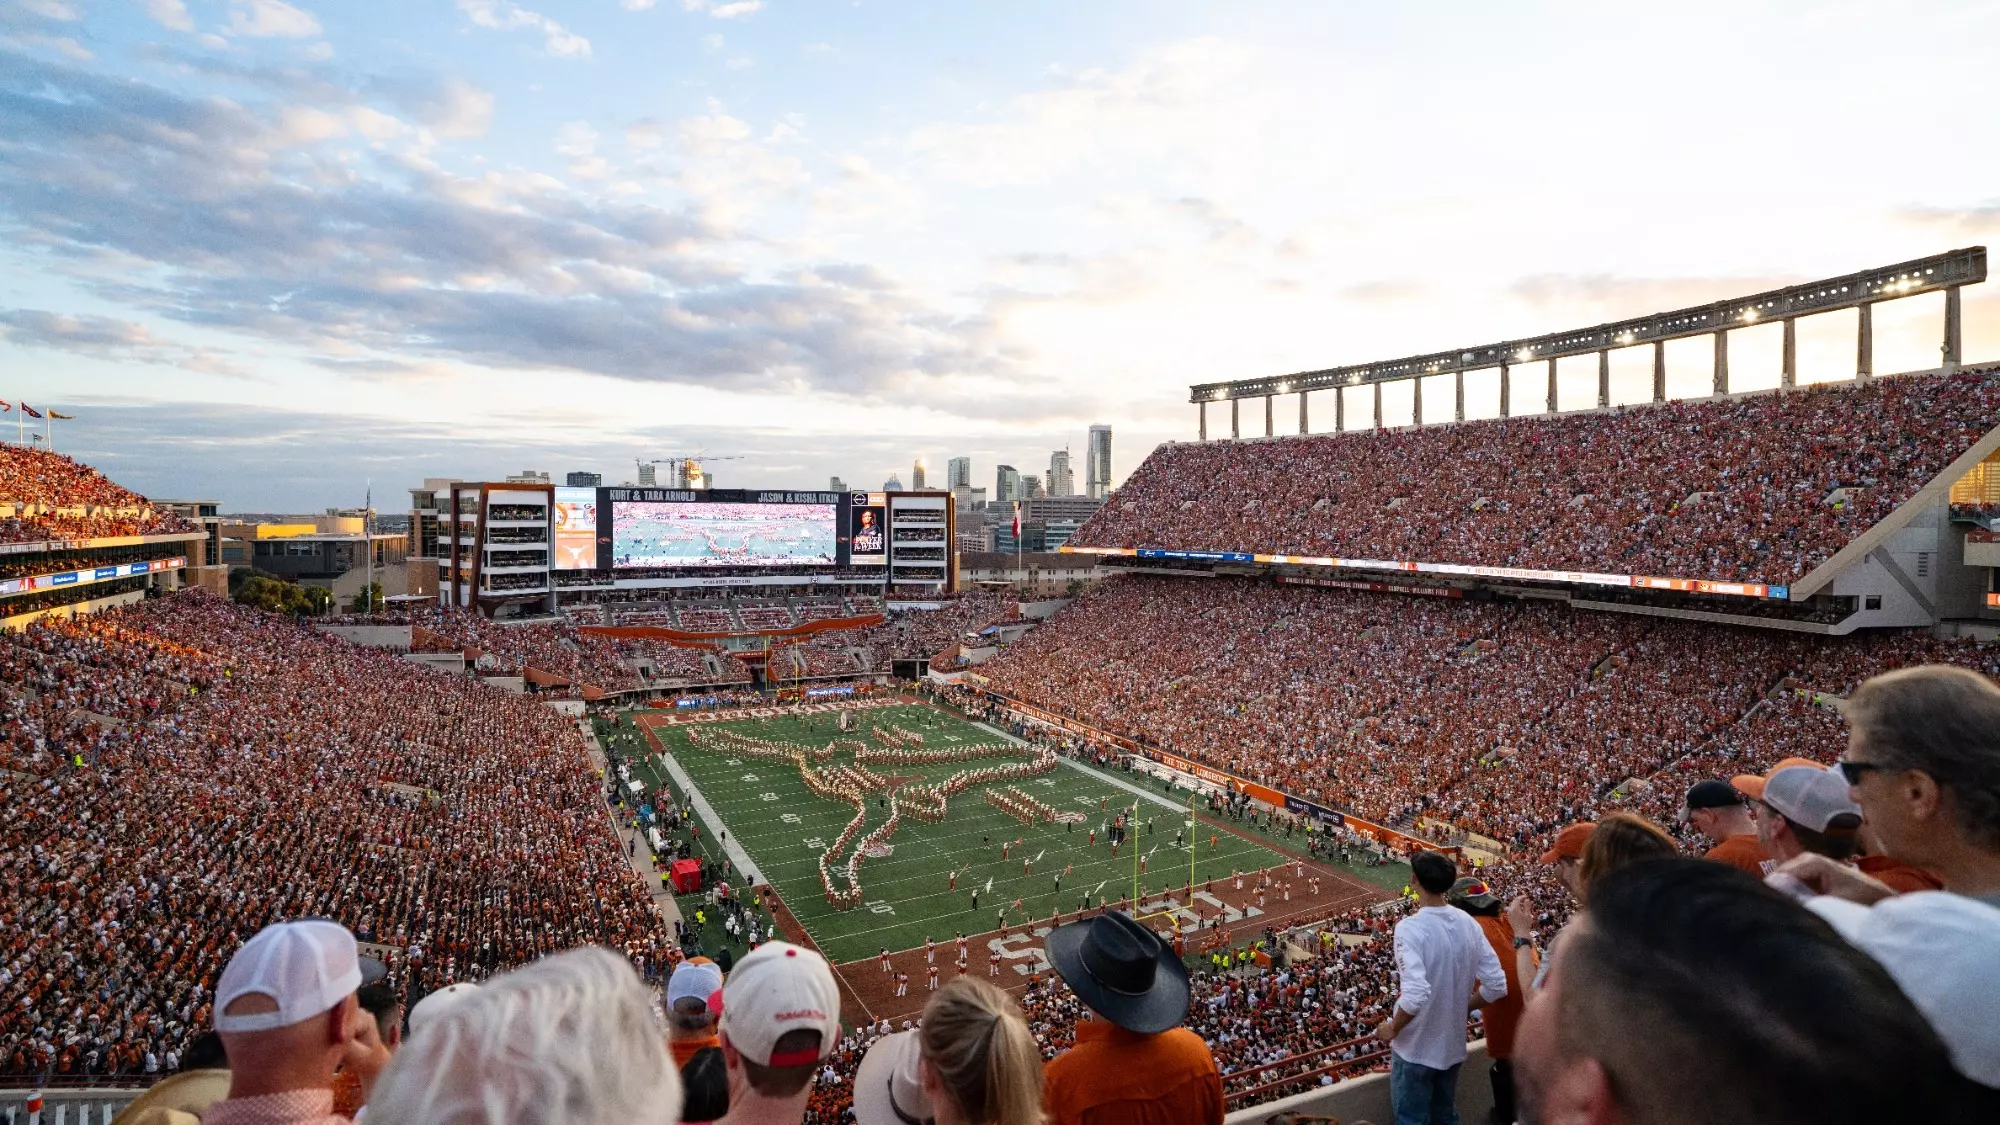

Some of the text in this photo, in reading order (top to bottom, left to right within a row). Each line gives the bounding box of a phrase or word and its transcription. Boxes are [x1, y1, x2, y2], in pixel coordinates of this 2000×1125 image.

[609, 490, 696, 501] KURT & TARA ARNOLD
[758, 493, 784, 503] JASON
[785, 493, 793, 503] &
